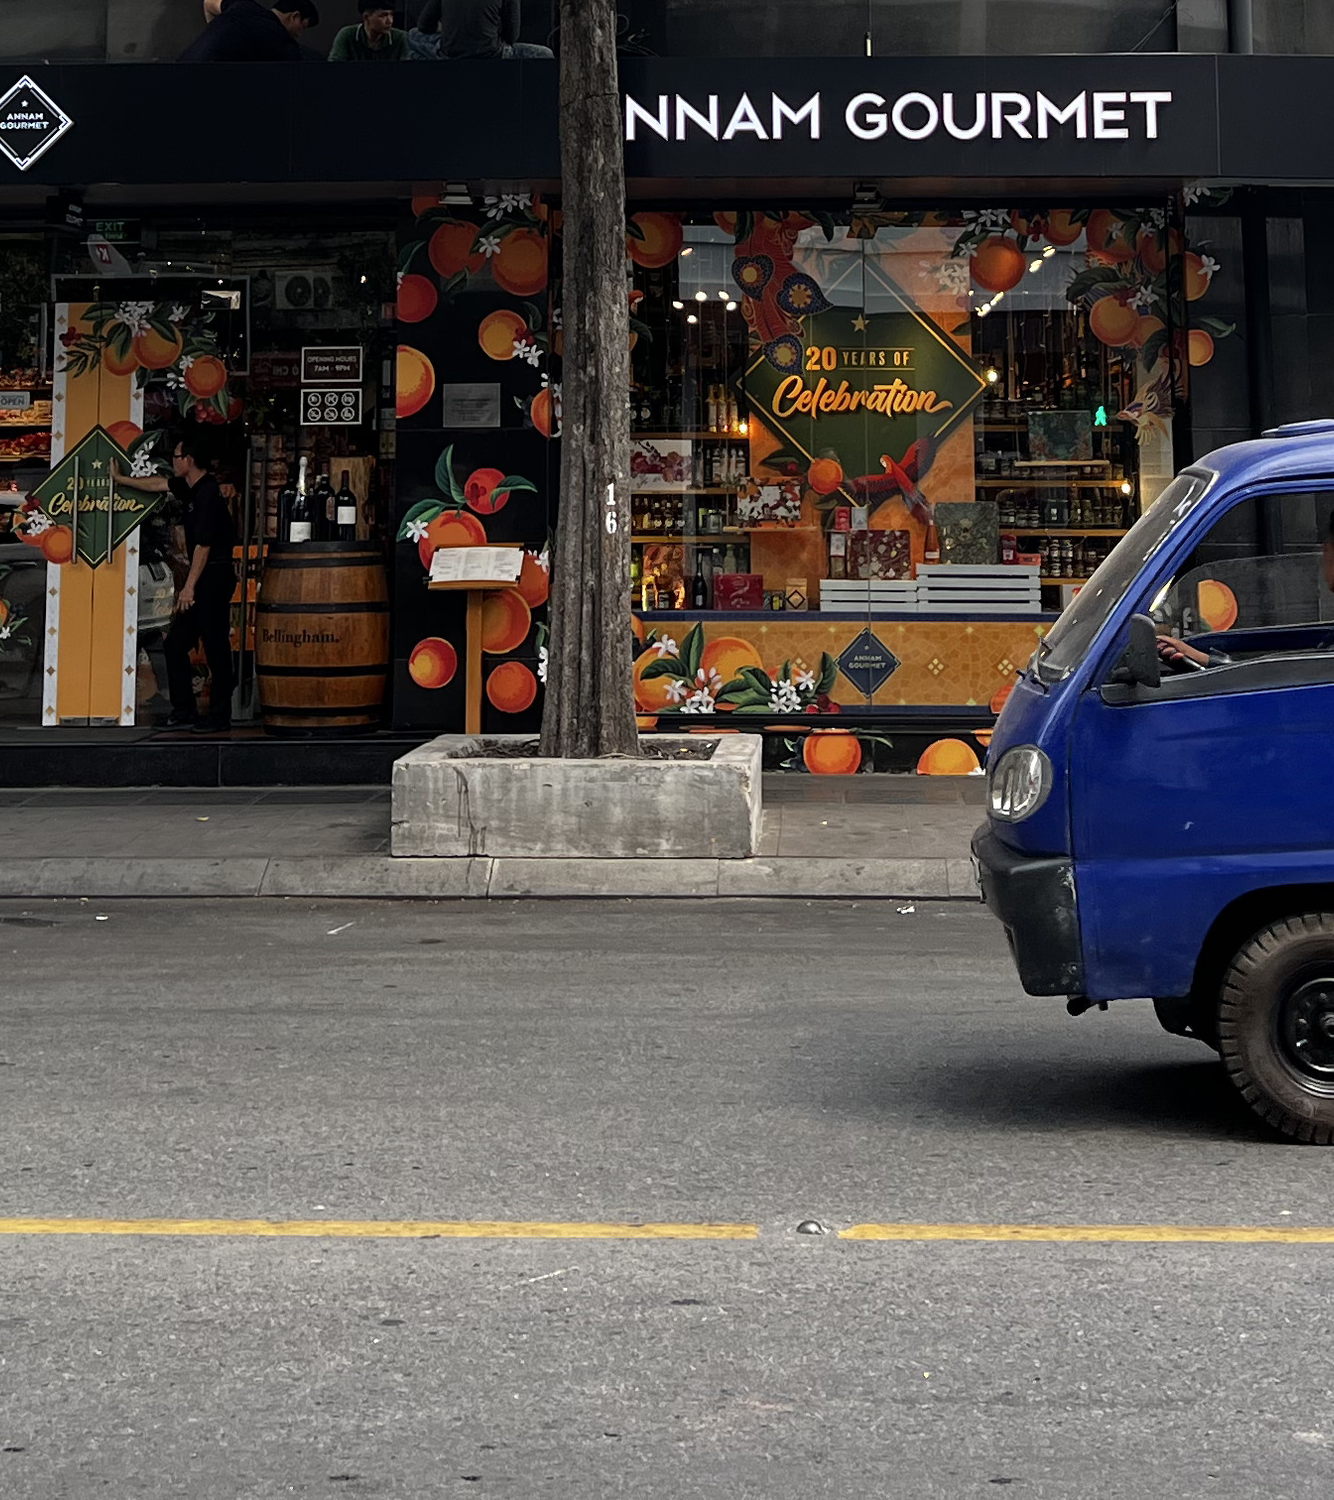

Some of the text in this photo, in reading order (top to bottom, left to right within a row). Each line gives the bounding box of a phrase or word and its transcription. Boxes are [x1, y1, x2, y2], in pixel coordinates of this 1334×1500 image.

[625, 91, 1172, 141] NNAM GOURMET
[0, 121, 49, 130] GOURMET
[95, 222, 125, 231] EXIT
[805, 346, 910, 371] 20 YEARS OF
[0, 397, 25, 406] OPEN
[772, 375, 954, 420] Celebration
